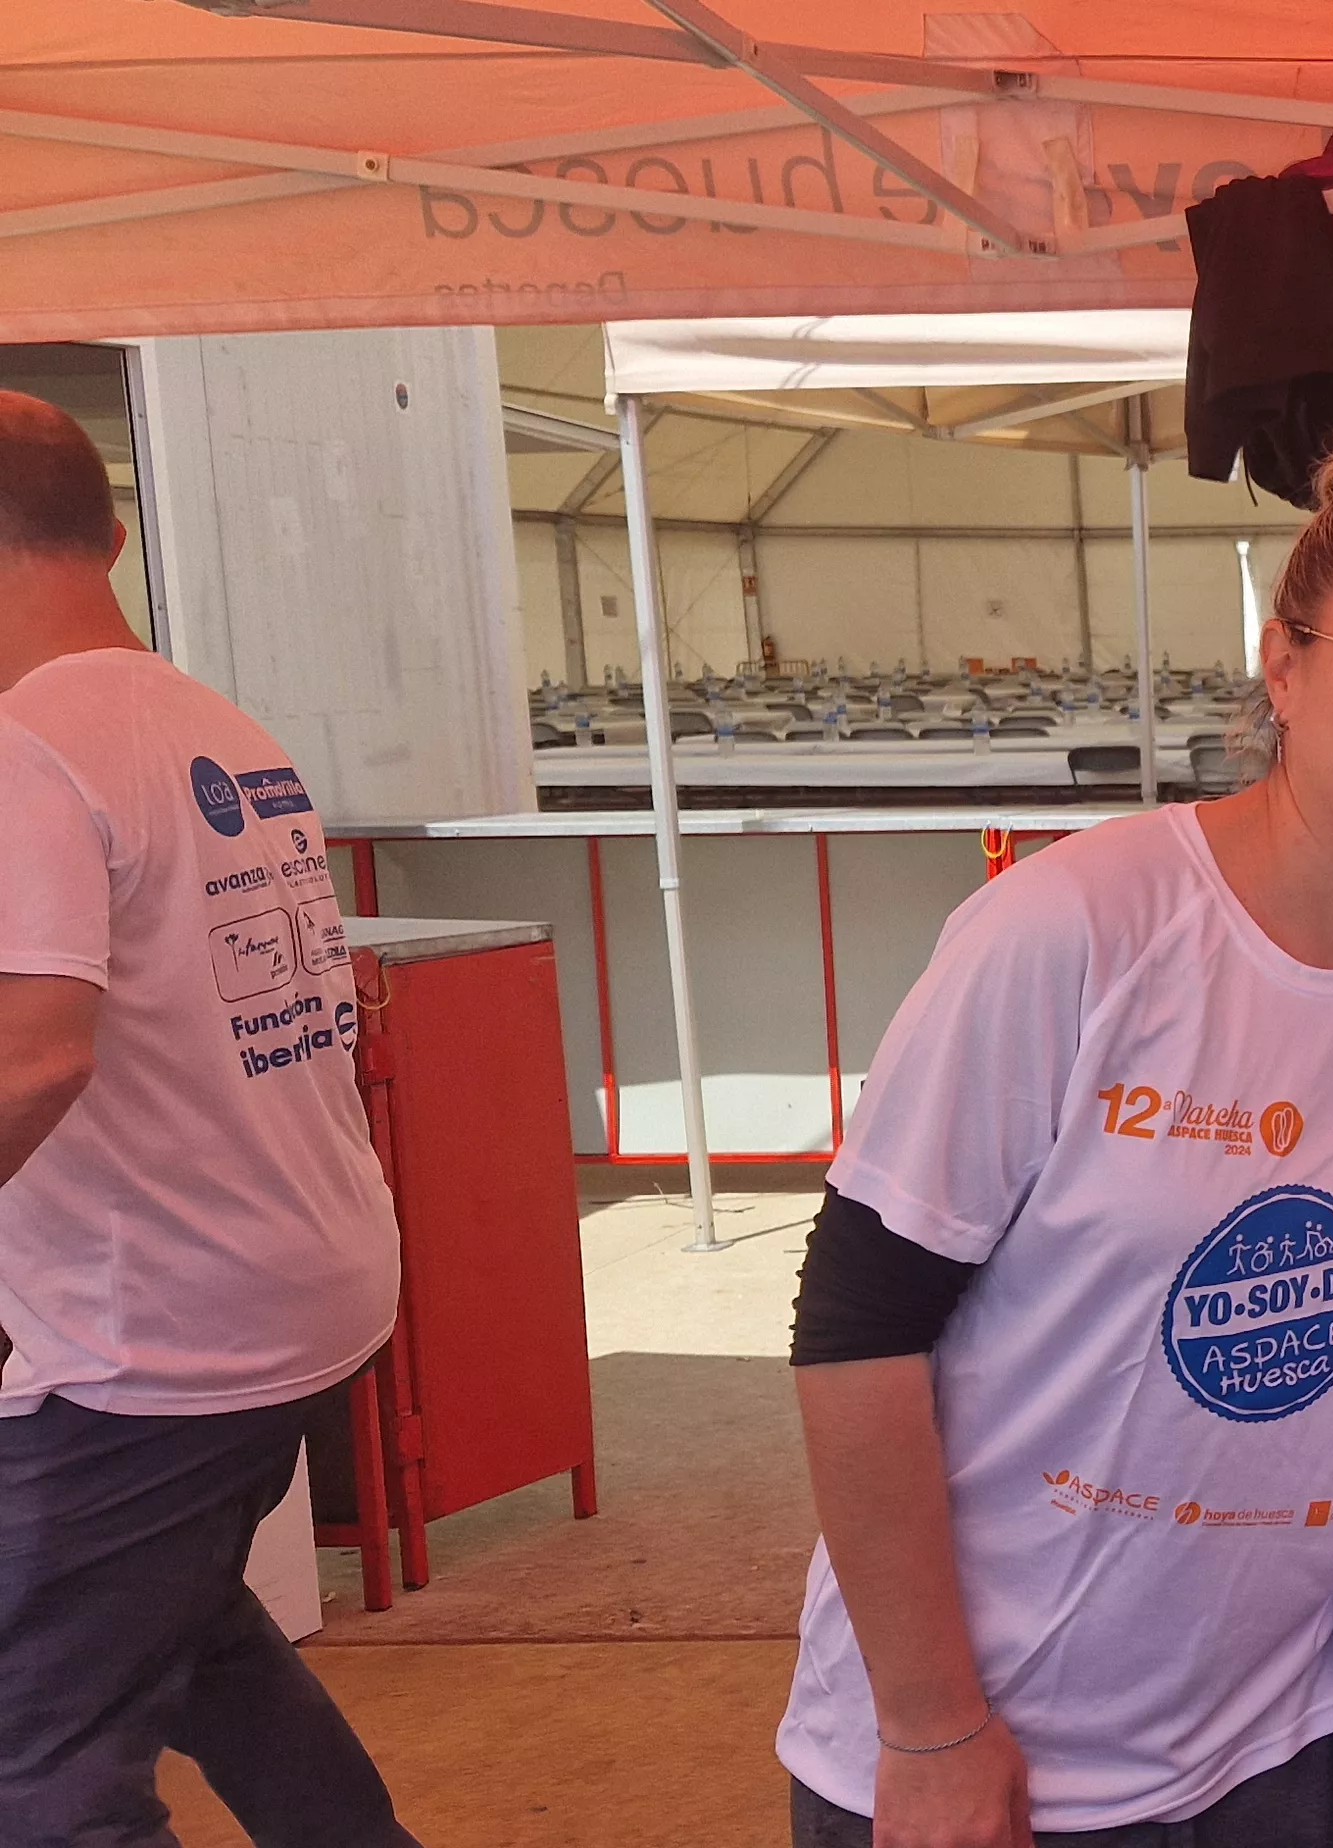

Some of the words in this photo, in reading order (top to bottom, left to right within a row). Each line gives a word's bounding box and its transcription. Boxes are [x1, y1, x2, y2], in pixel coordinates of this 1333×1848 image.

[205, 866, 266, 896] avanza
[1173, 1090, 1254, 1128] Marcha
[1168, 1124, 1210, 1140] ASPACE
[1214, 1128, 1252, 1143] HUESCA
[1224, 1144, 1251, 1156] 2024
[1220, 1354, 1331, 1396] Huesca
[1069, 1475, 1160, 1511] ASPACE
[1203, 1508, 1235, 1522] hoya
[1237, 1509, 1252, 1520] de
[1253, 1508, 1295, 1520] huesca
